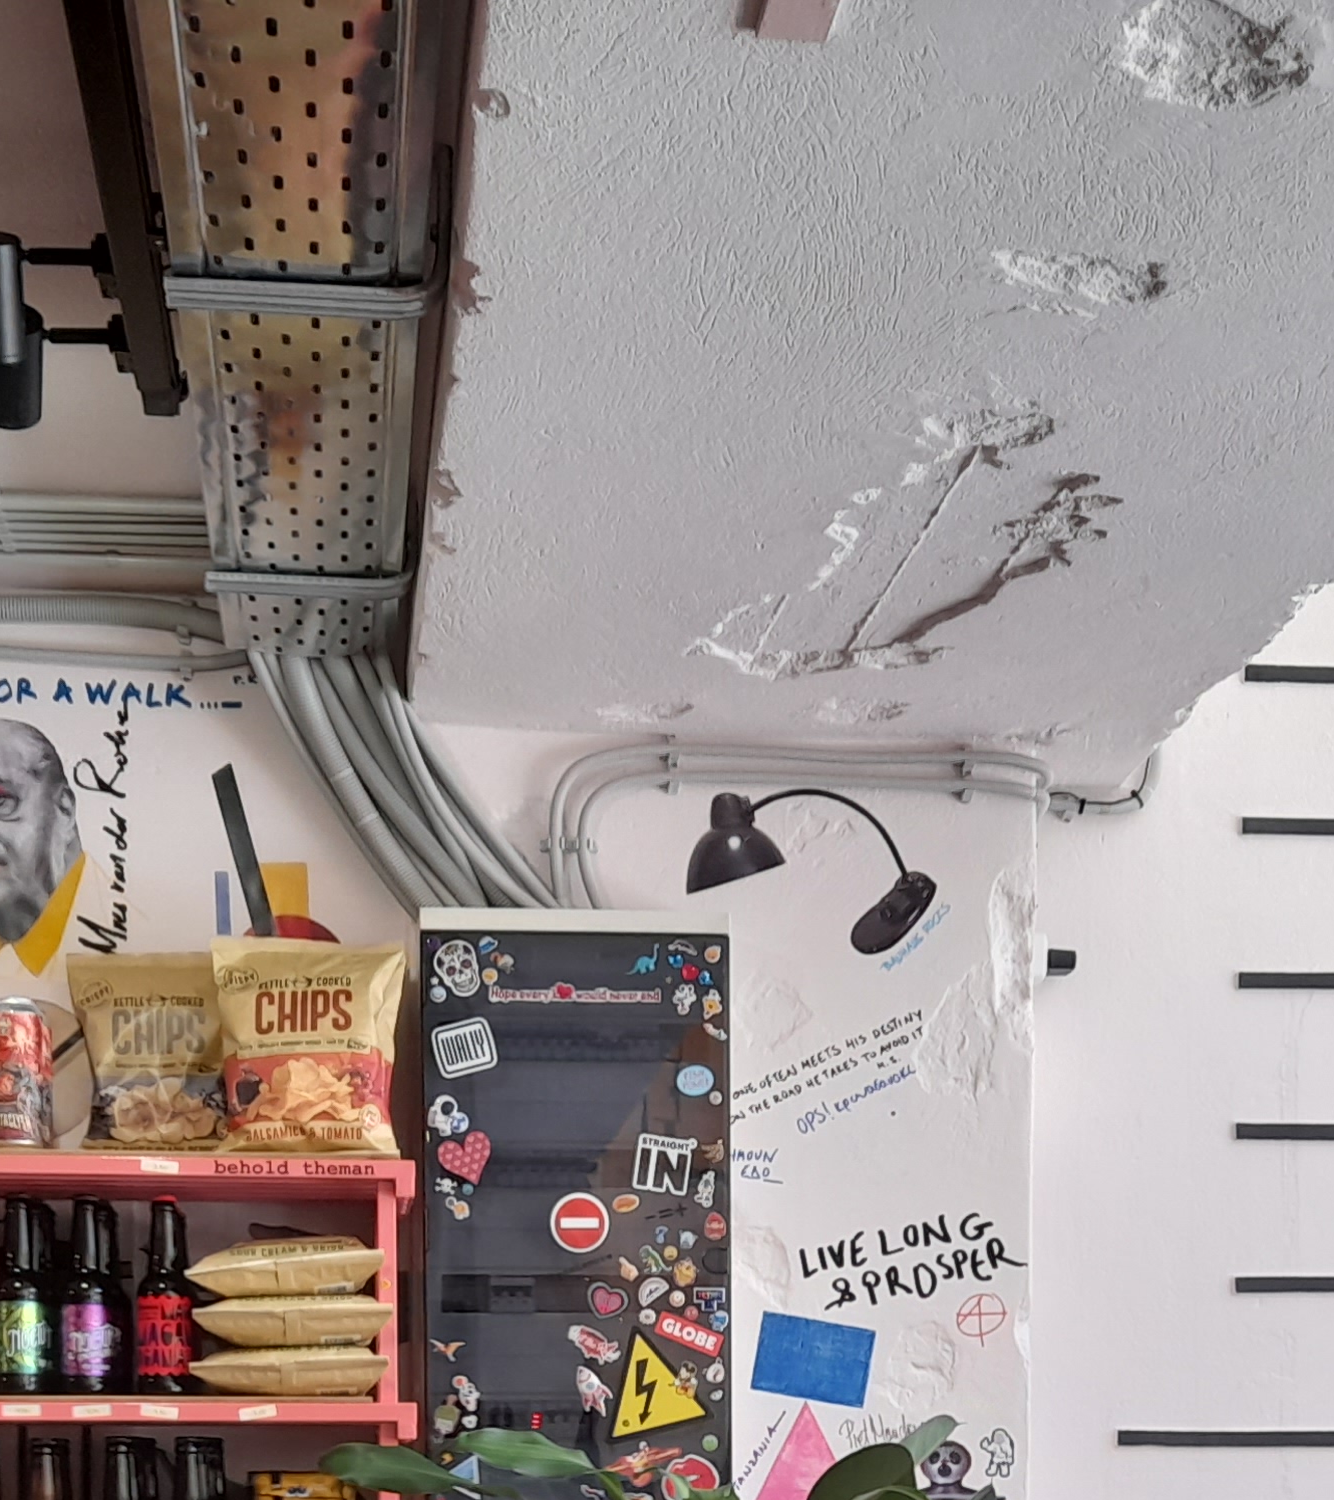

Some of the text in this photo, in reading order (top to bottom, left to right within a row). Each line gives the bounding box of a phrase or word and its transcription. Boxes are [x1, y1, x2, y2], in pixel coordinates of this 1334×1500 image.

[52, 680, 75, 704] A
[111, 1008, 206, 1056] CHIPS
[254, 988, 353, 1036] CHIPS
[801, 1044, 843, 1072] MEETS
[845, 1033, 867, 1052] HIS
[872, 1009, 924, 1040] DESTINY
[748, 1098, 772, 1116] THE
[773, 1084, 802, 1104] ROAD
[806, 1074, 823, 1090] HE
[824, 1059, 859, 1082] TAKES
[862, 1050, 877, 1065] TO
[912, 1026, 926, 1043] IT
[320, 1126, 363, 1141] TOMATO
[213, 1161, 376, 1176] behold theman
[635, 1147, 691, 1194] IN
[799, 1212, 995, 1279] LIVE LONG
[824, 1237, 1029, 1311] & PROSPER
[661, 1317, 718, 1351] GLOBE
